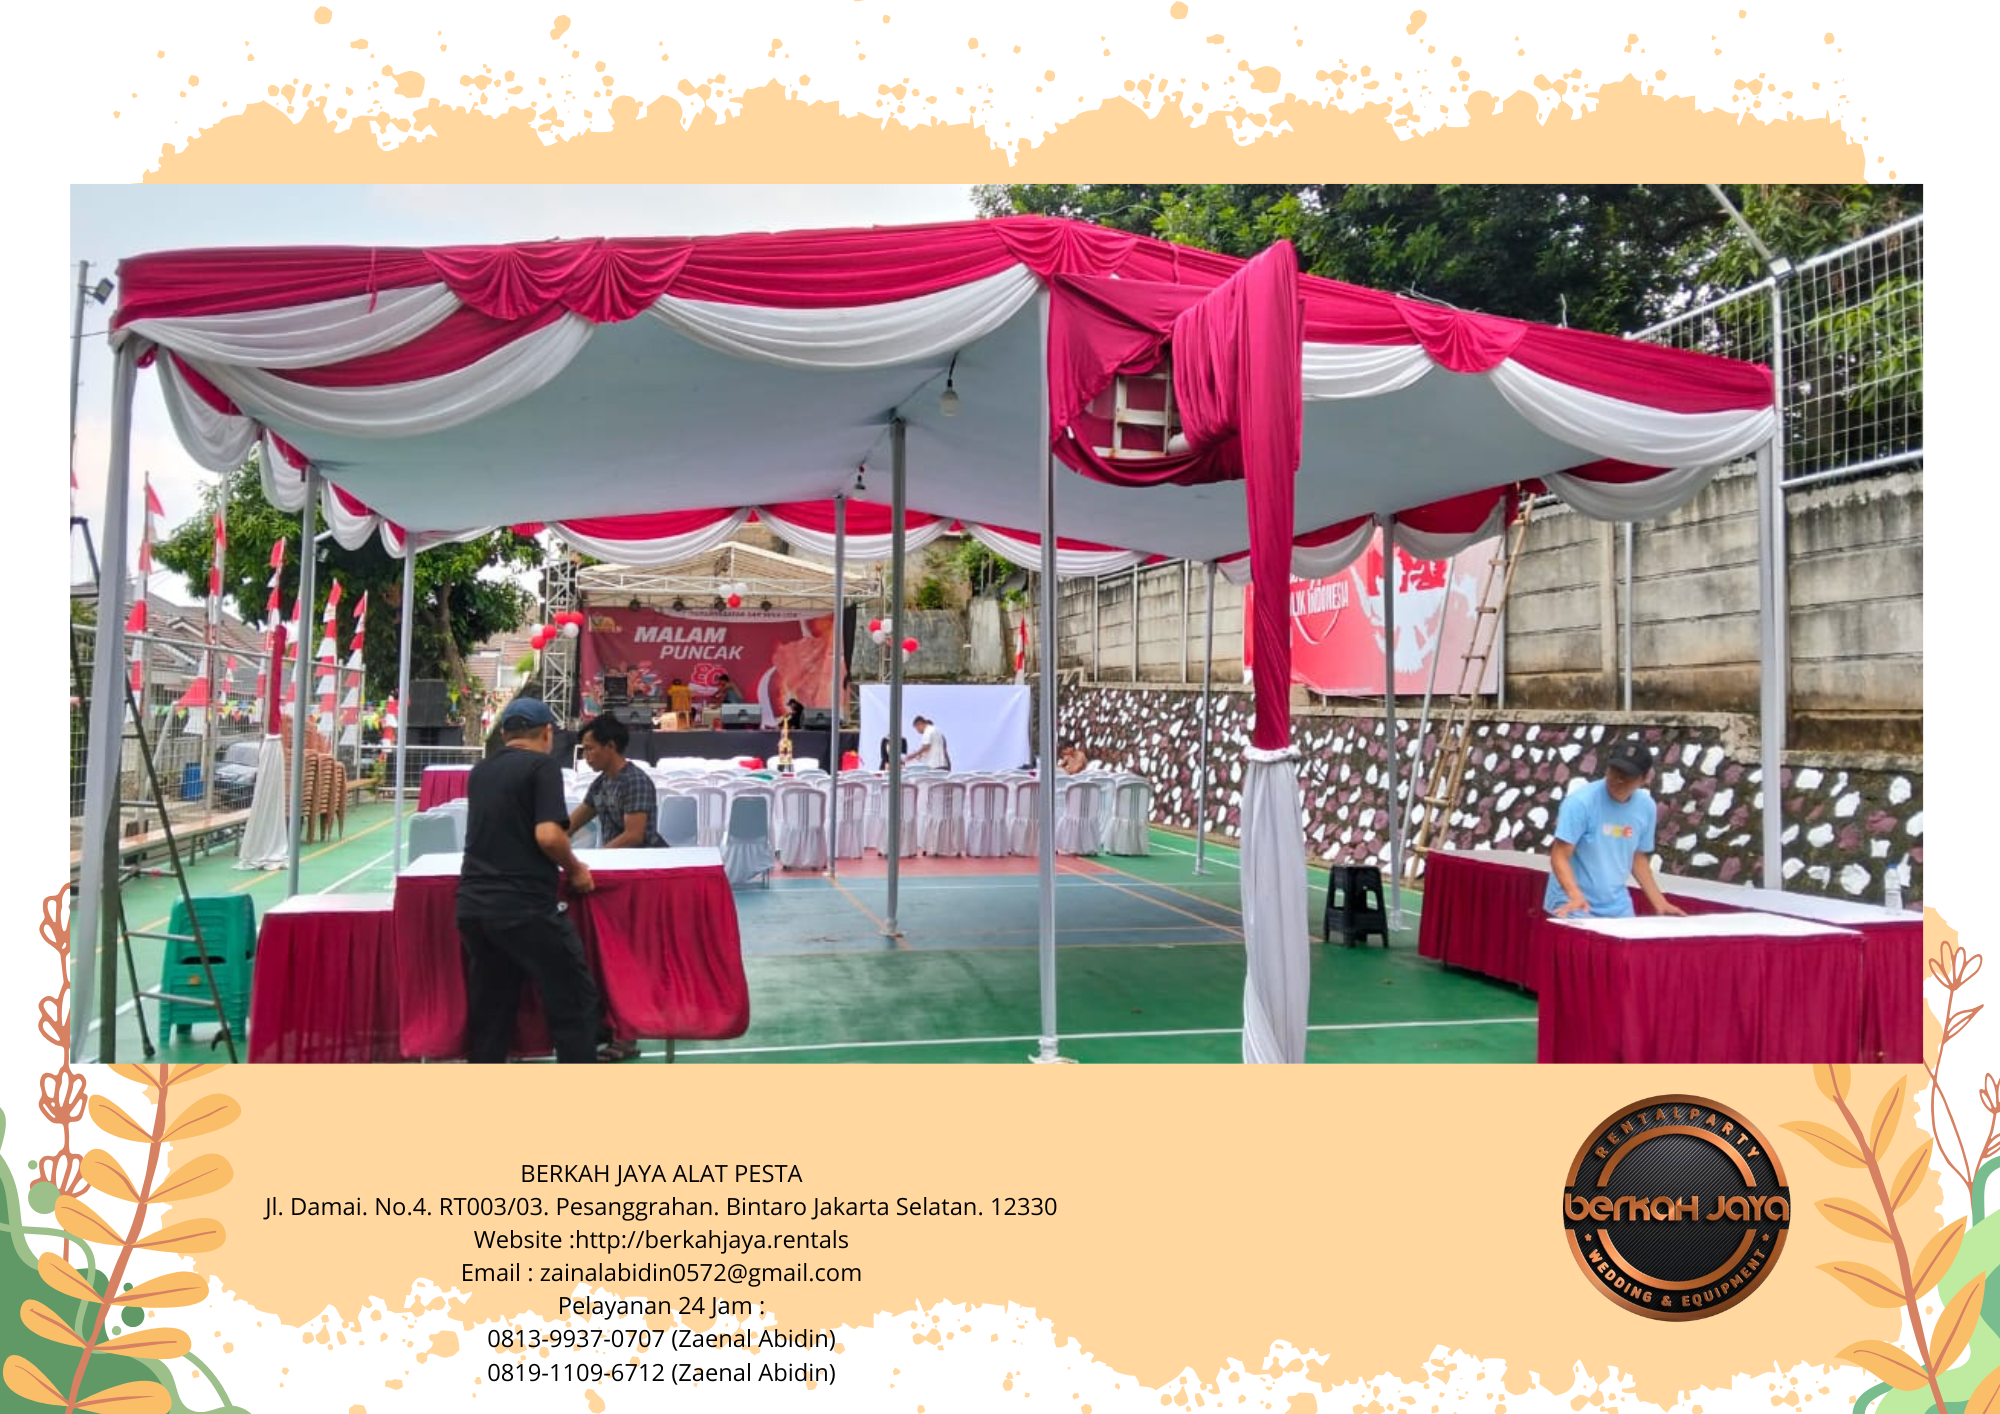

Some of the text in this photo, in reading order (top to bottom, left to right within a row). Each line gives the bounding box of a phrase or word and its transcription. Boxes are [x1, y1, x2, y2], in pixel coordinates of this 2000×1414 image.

[1290, 581, 1348, 616] LIK INDONESIA
[634, 625, 728, 643] MALAM
[659, 644, 745, 661] PUNCAK
